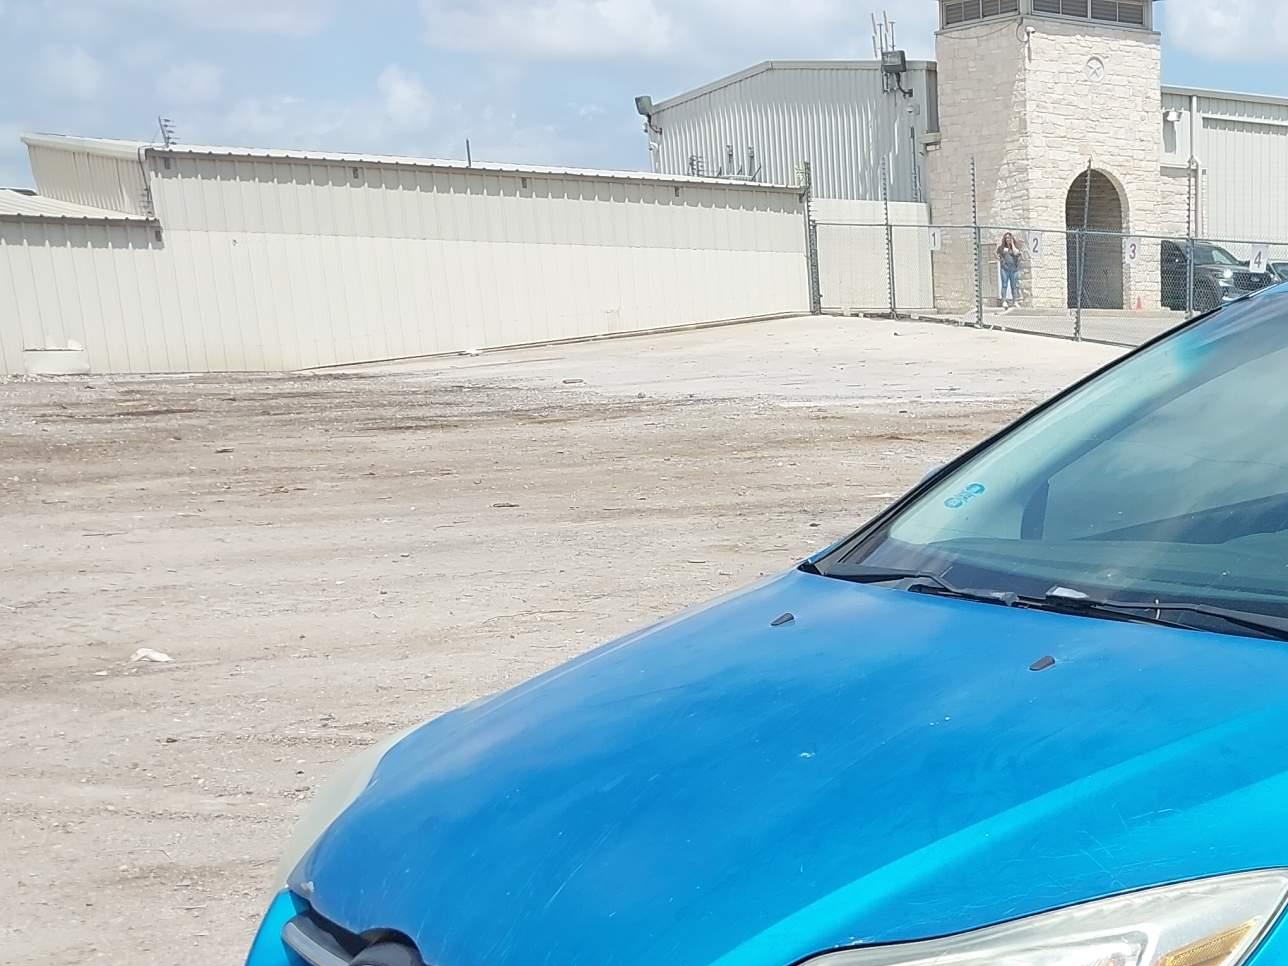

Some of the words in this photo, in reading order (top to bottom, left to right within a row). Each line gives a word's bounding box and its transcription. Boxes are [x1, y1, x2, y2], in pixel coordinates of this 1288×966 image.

[1032, 238, 1039, 253] 2
[1129, 243, 1137, 260] 3
[1253, 251, 1263, 269] 4
